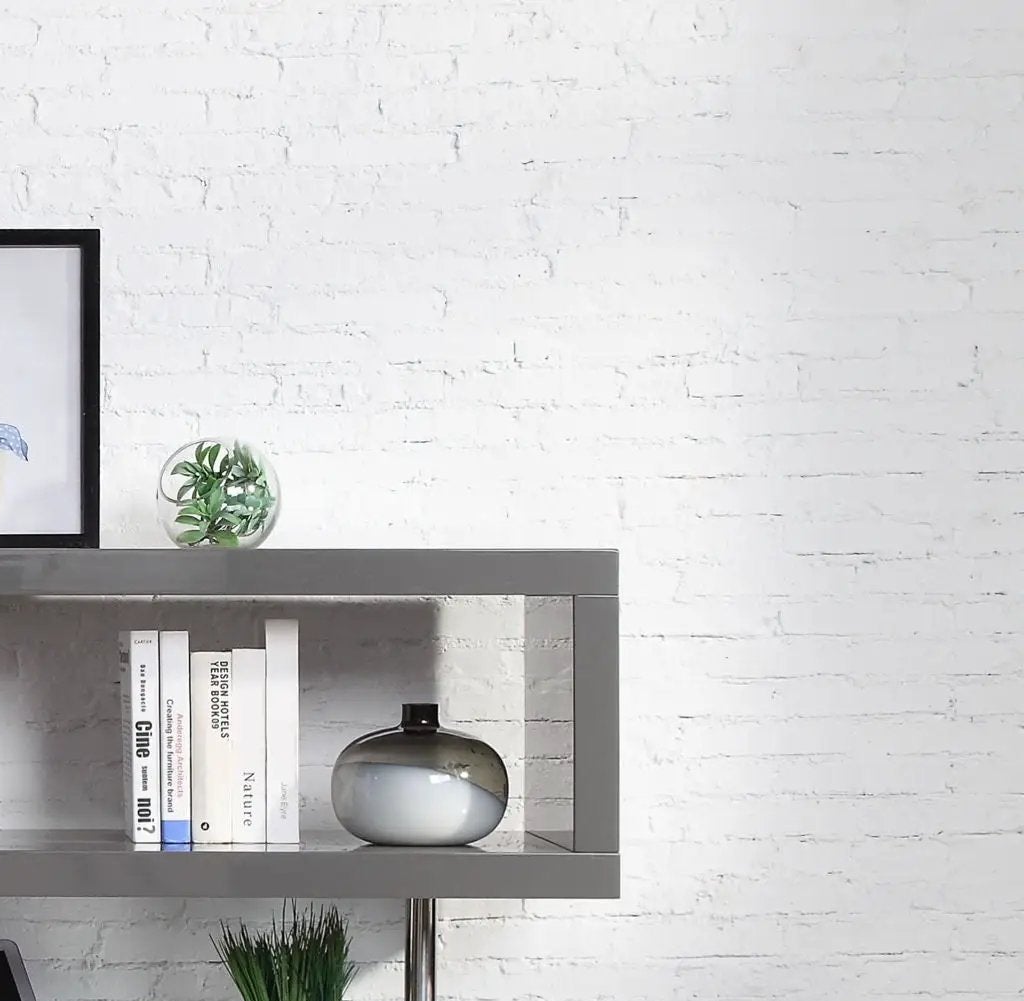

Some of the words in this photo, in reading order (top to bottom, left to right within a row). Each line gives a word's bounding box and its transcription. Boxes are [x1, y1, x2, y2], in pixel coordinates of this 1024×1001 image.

[210, 661, 220, 687] YEAR
[220, 661, 229, 697] DESIGN
[164, 699, 174, 734] Creating
[220, 701, 230, 739] HOTELS
[135, 721, 153, 758] Cine
[166, 736, 174, 749] the
[166, 751, 174, 787] furniture
[176, 756, 184, 798] Architects
[243, 772, 255, 827] Nature
